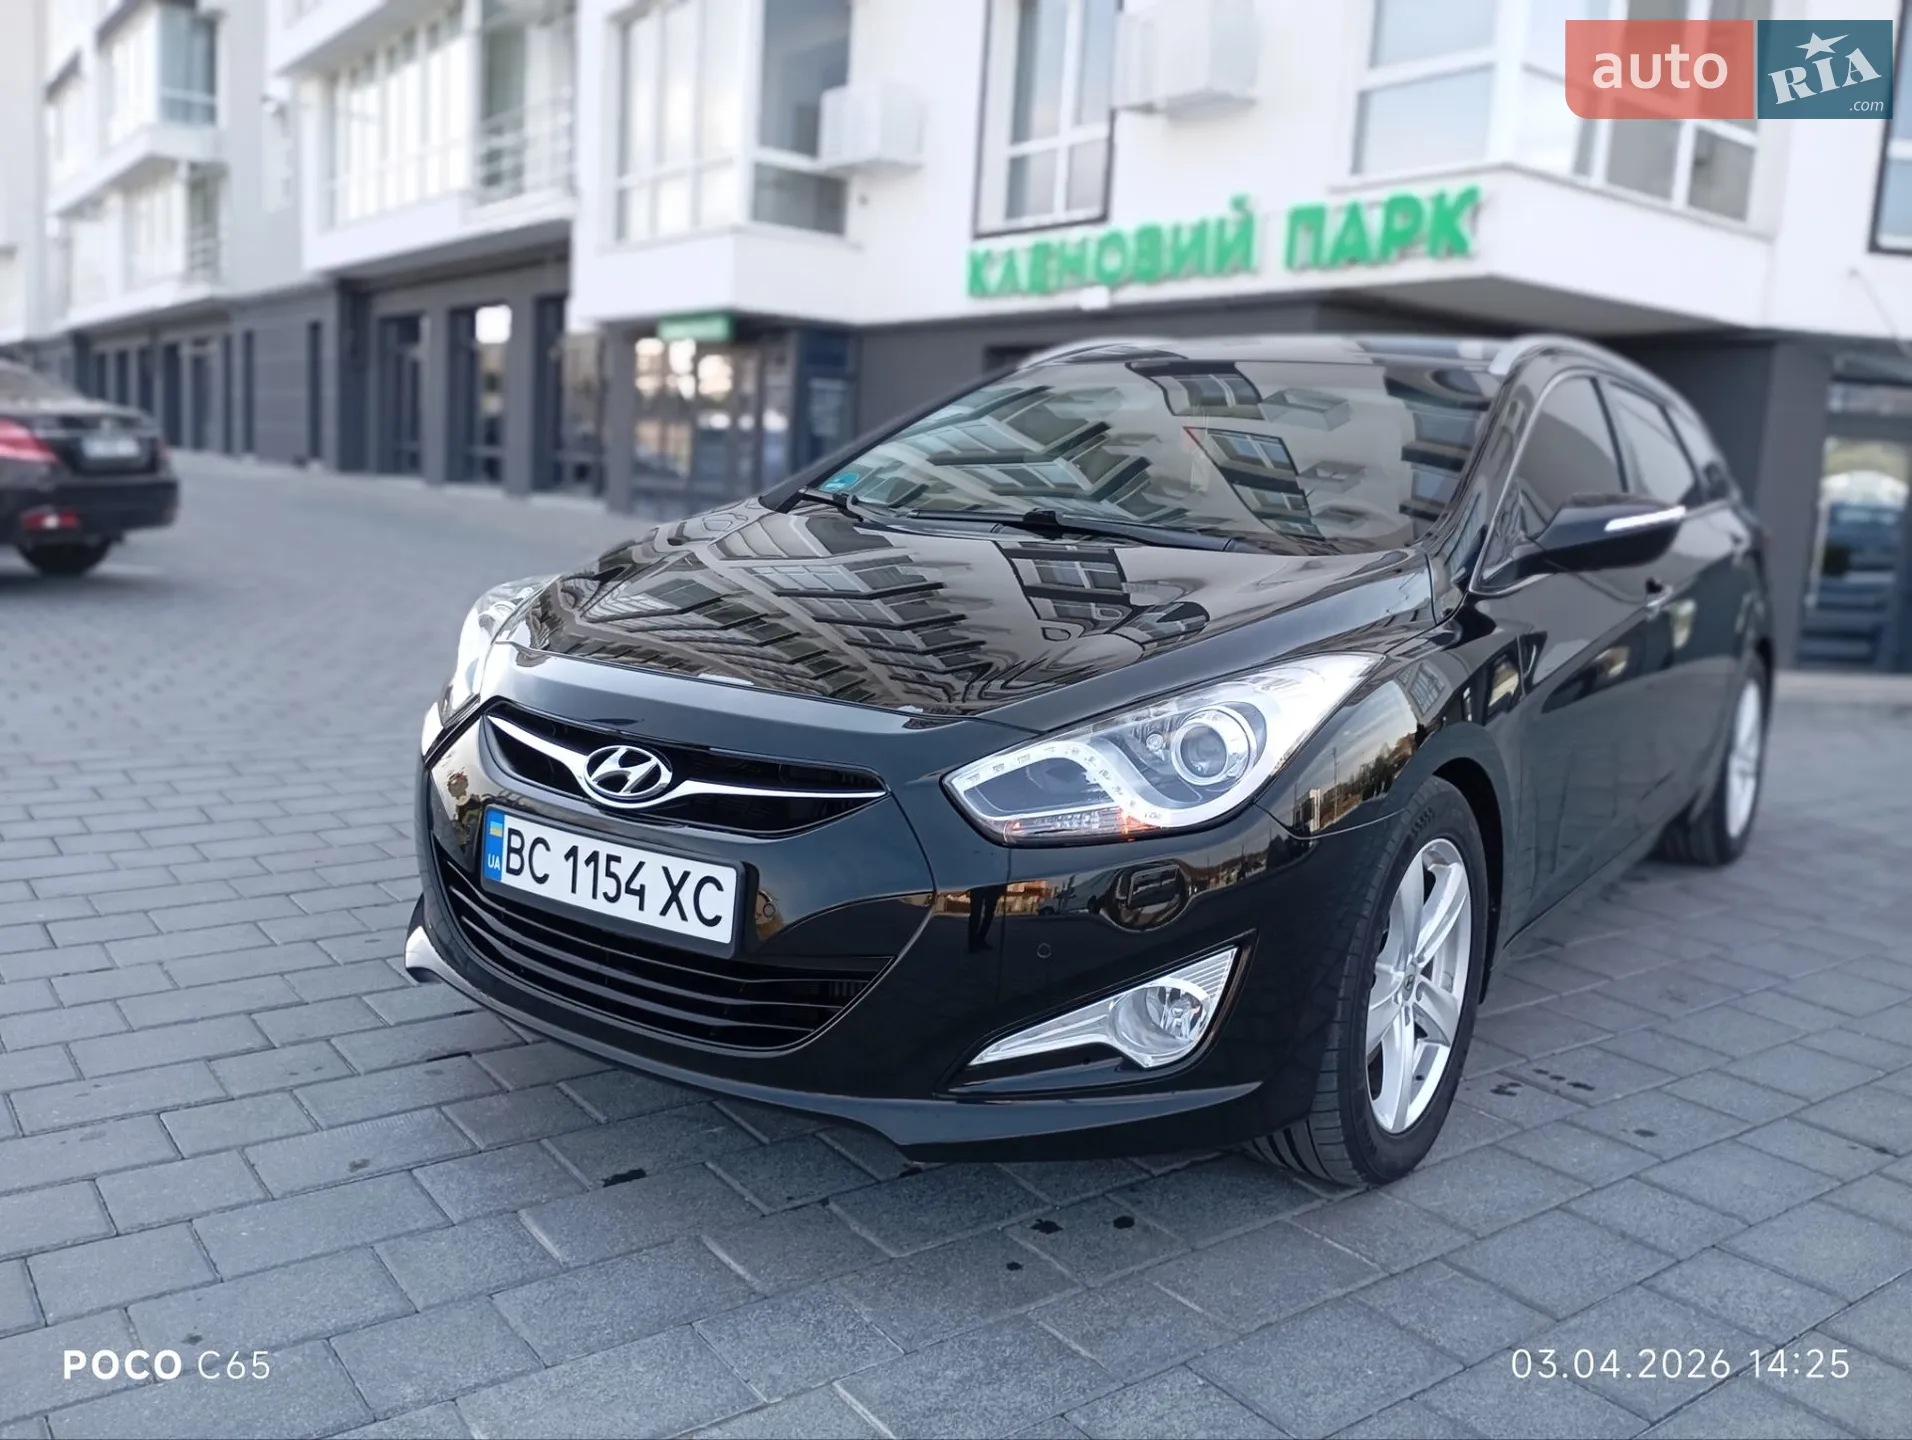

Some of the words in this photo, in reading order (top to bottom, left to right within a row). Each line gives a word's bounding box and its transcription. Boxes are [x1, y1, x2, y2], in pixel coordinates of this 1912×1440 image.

[967, 194, 1257, 298] КЛЕНОВИЙ
[1285, 186, 1482, 272] ПАРК
[487, 853, 501, 871] UA
[505, 827, 551, 885] BC
[564, 845, 646, 912] 1154
[659, 865, 724, 928] XC
